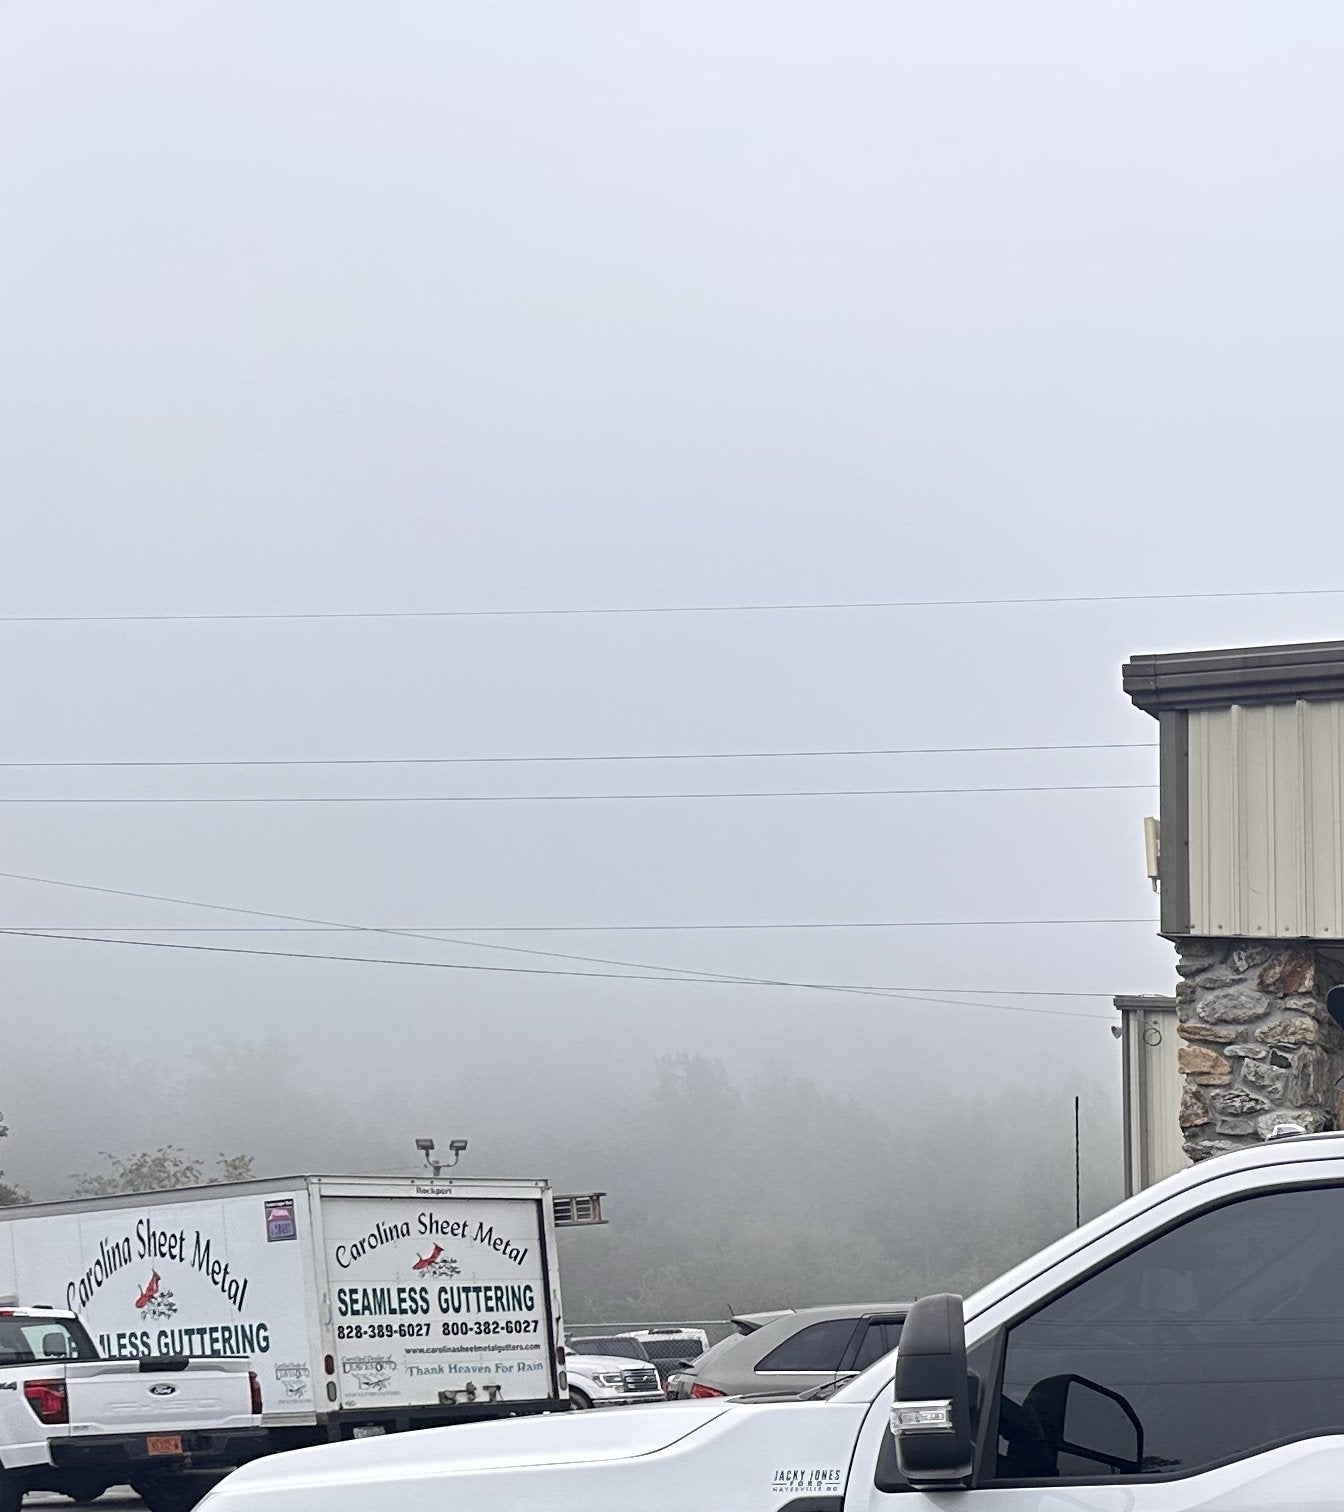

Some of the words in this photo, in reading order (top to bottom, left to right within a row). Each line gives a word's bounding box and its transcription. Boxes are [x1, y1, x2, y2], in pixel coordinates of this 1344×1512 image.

[335, 1220, 411, 1269] Carolina
[417, 1212, 469, 1239] Sheet
[473, 1221, 529, 1266] Metal
[66, 1237, 132, 1312] Carolina
[136, 1218, 185, 1262] Sheet
[190, 1230, 248, 1313] Metal
[337, 1286, 430, 1316] SEAMLESS
[438, 1284, 535, 1314] GUTTERING
[157, 1322, 270, 1357] GUTTERING
[337, 1323, 431, 1339] 828-389-6027
[441, 1320, 539, 1336] 800-382-6027
[406, 1364, 445, 1377] Thank
[448, 1363, 491, 1374] Heaven
[494, 1362, 514, 1374] For
[517, 1361, 544, 1372] Rain
[773, 1469, 805, 1481] JACKY
[809, 1469, 841, 1482] JONES
